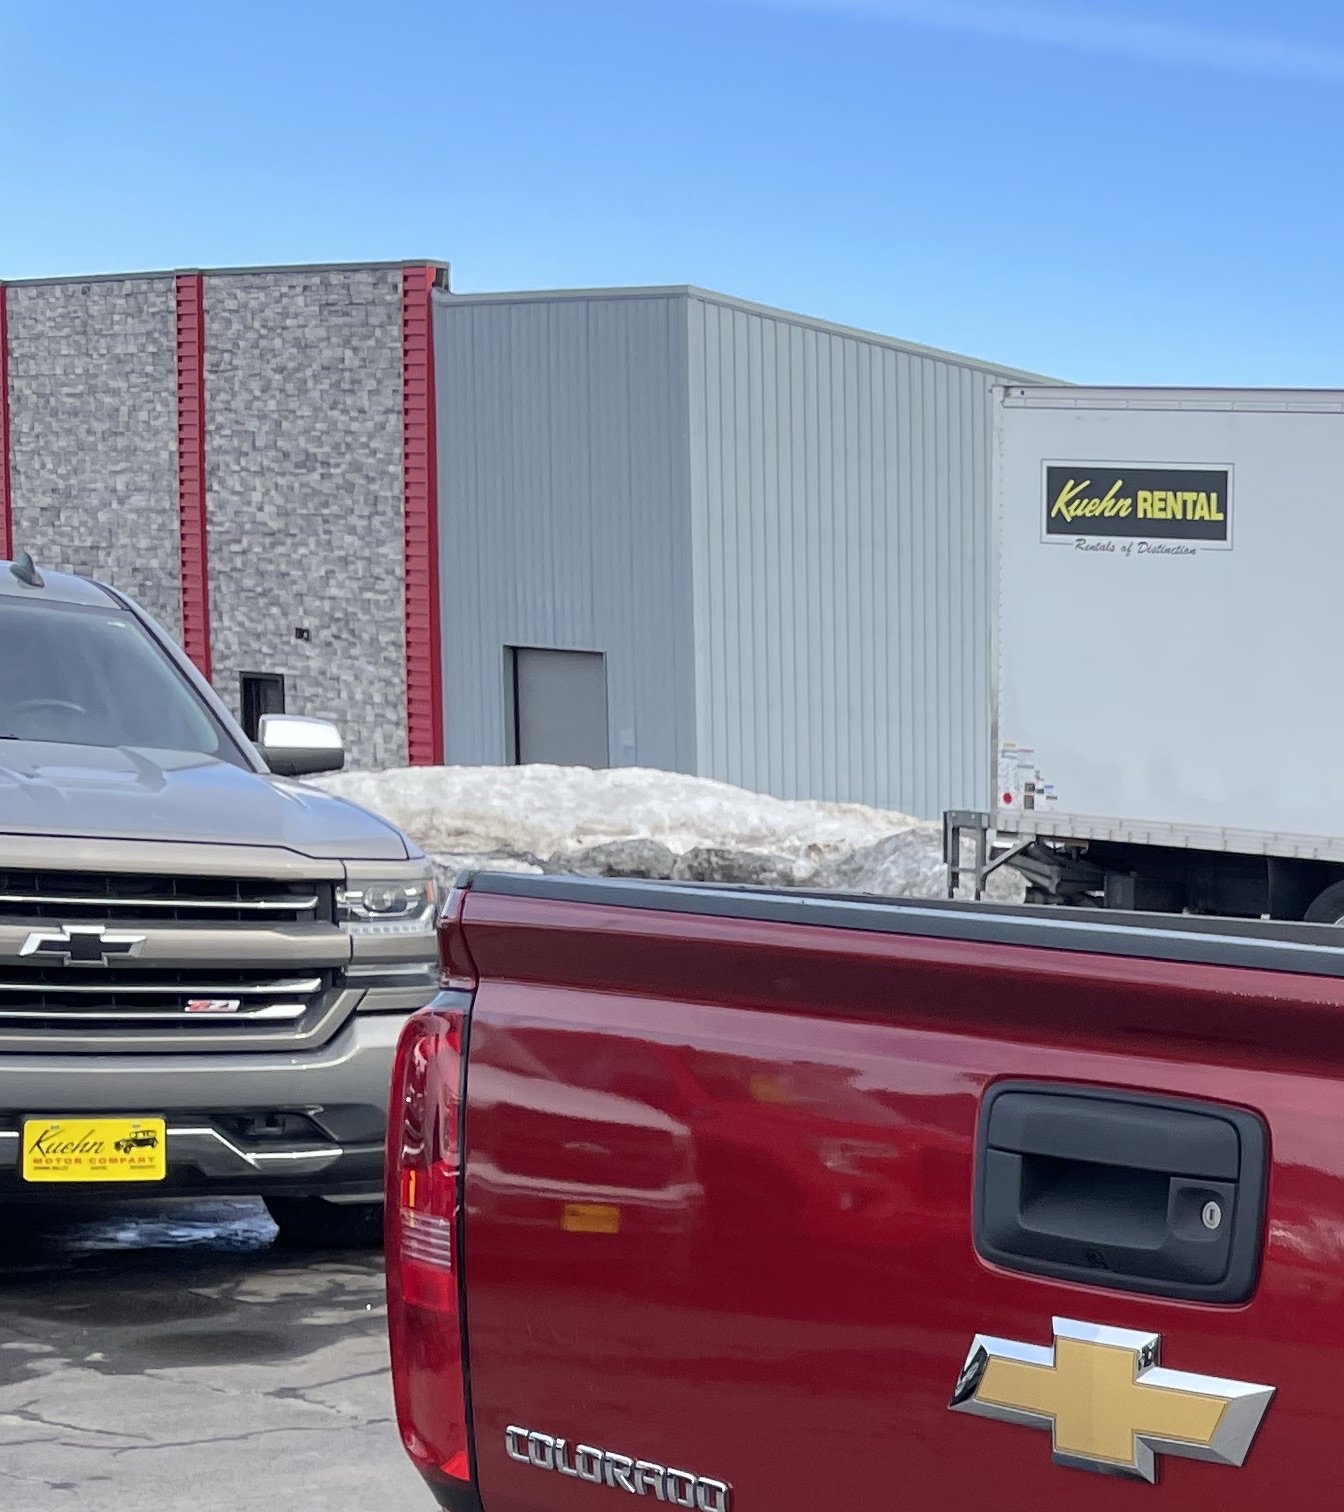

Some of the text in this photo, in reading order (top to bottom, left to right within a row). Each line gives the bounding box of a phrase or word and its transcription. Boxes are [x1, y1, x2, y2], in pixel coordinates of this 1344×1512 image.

[1051, 479, 1224, 522] Kuehn RENTAL
[1074, 538, 1197, 557] Rentals of Distinction
[28, 1129, 105, 1158] Kuehn
[33, 1156, 155, 1165] MOTOR COMPANY
